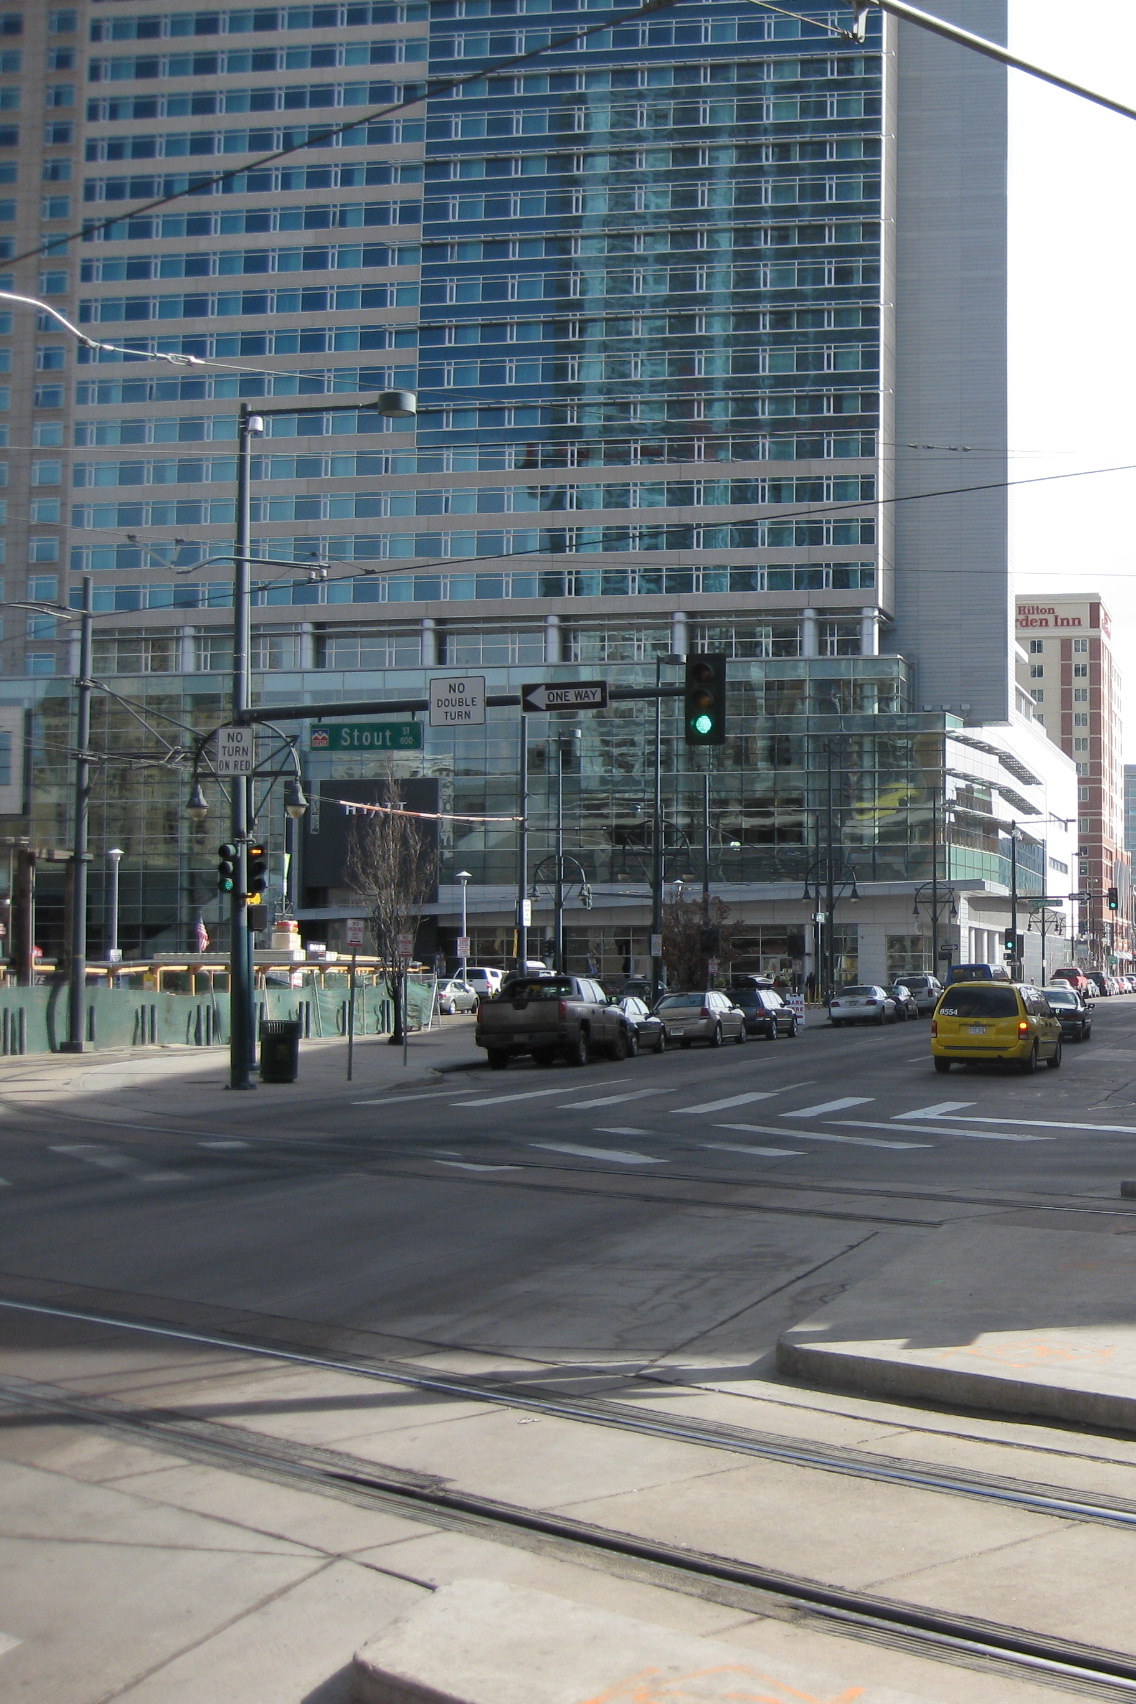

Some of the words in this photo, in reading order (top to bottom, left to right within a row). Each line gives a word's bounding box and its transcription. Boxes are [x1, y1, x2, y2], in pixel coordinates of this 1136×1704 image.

[1018, 605, 1056, 615] Hilton
[1053, 614, 1082, 627] Inn
[448, 682, 466, 694] NO
[547, 690, 571, 702] ONE
[574, 689, 599, 701] WAY
[436, 697, 477, 708] DOUBLE
[444, 711, 471, 721] TURN
[227, 732, 243, 743] NO
[341, 727, 391, 746] Stout
[222, 745, 249, 757] TURN
[219, 760, 230, 771] ON
[234, 760, 251, 771] RED
[346, 801, 408, 818] HYATT
[940, 1008, 959, 1016] 8554
